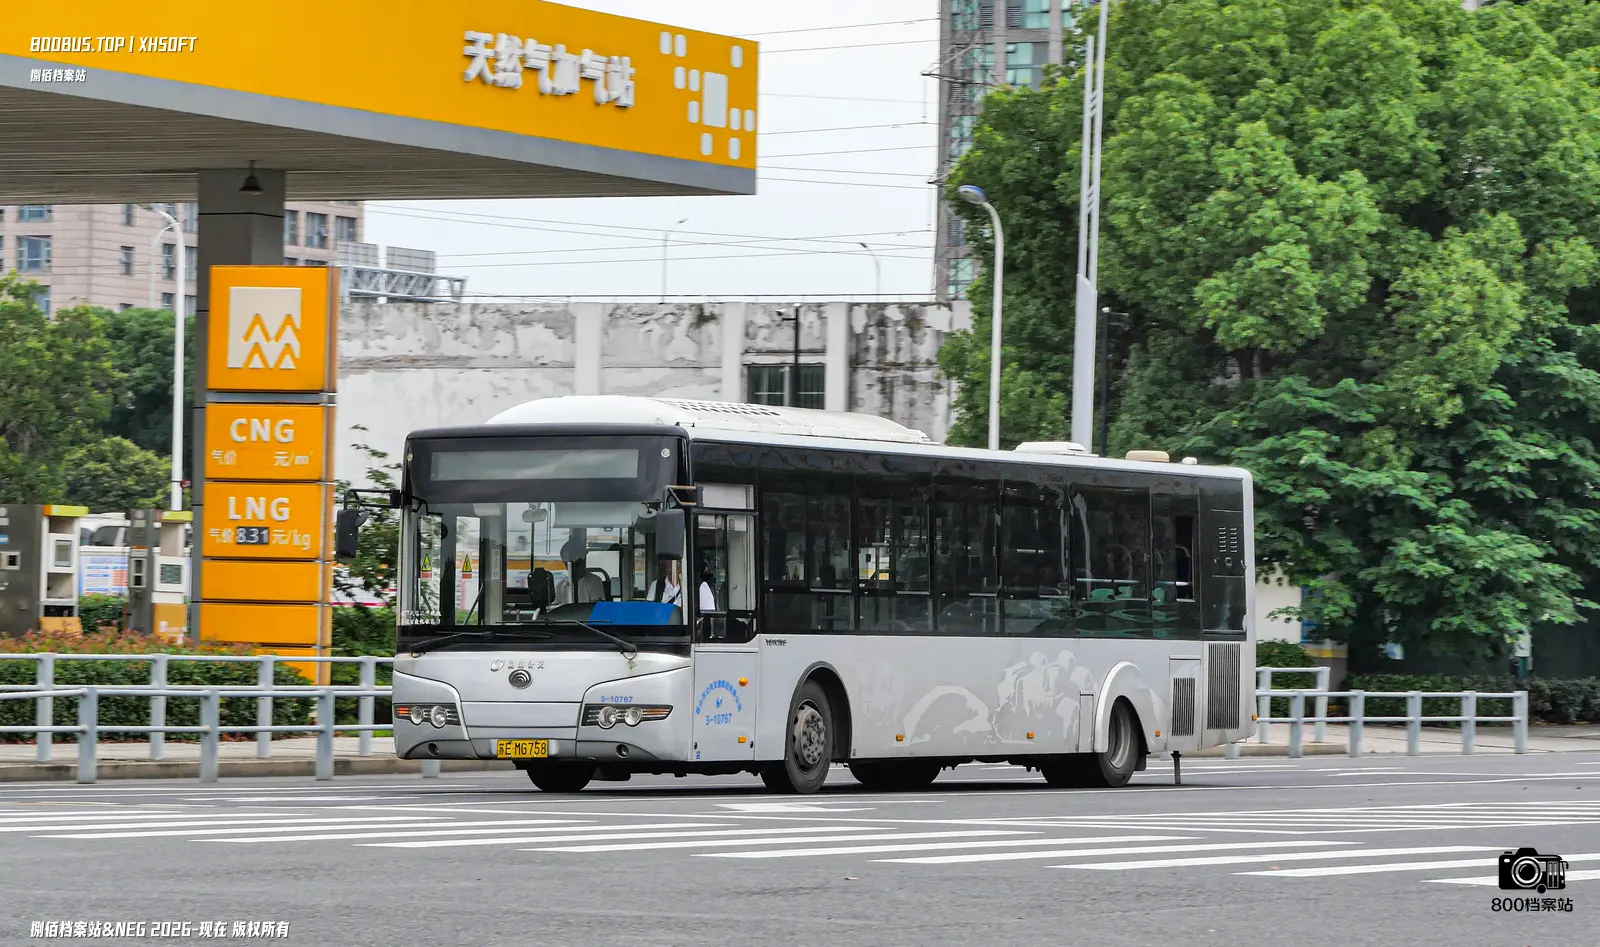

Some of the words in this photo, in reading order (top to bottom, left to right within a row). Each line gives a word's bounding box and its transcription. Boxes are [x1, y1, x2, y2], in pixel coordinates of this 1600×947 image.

[463, 30, 636, 107] 天然气加气站
[230, 418, 295, 443] CNG
[228, 496, 290, 521] LNG
[272, 529, 311, 551] 元/kg
[600, 695, 633, 703] 3-10767
[705, 713, 732, 726] 3-10767
